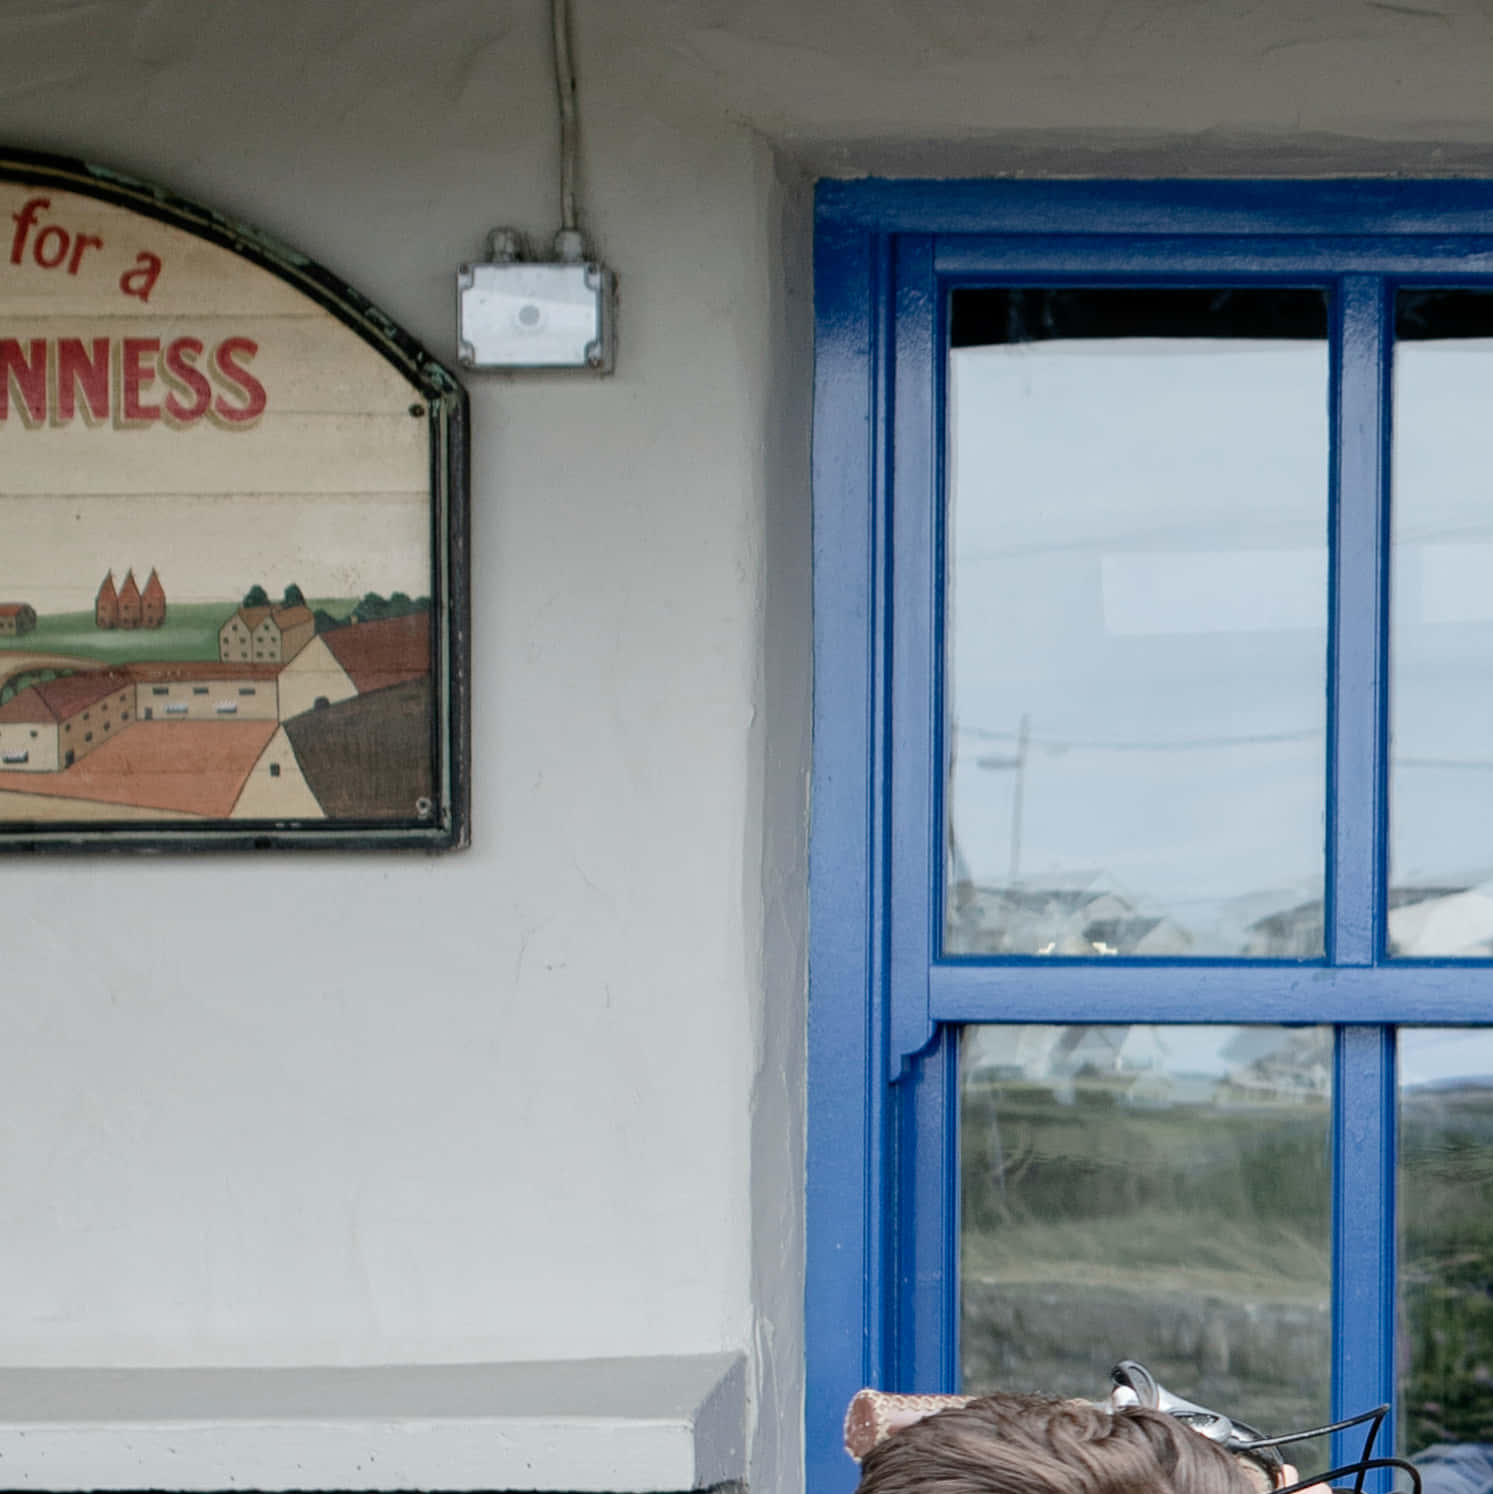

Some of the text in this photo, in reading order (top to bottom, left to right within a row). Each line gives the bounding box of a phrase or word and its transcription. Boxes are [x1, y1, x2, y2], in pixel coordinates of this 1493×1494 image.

[10, 196, 163, 304] for a
[0, 335, 267, 431] NNESS
